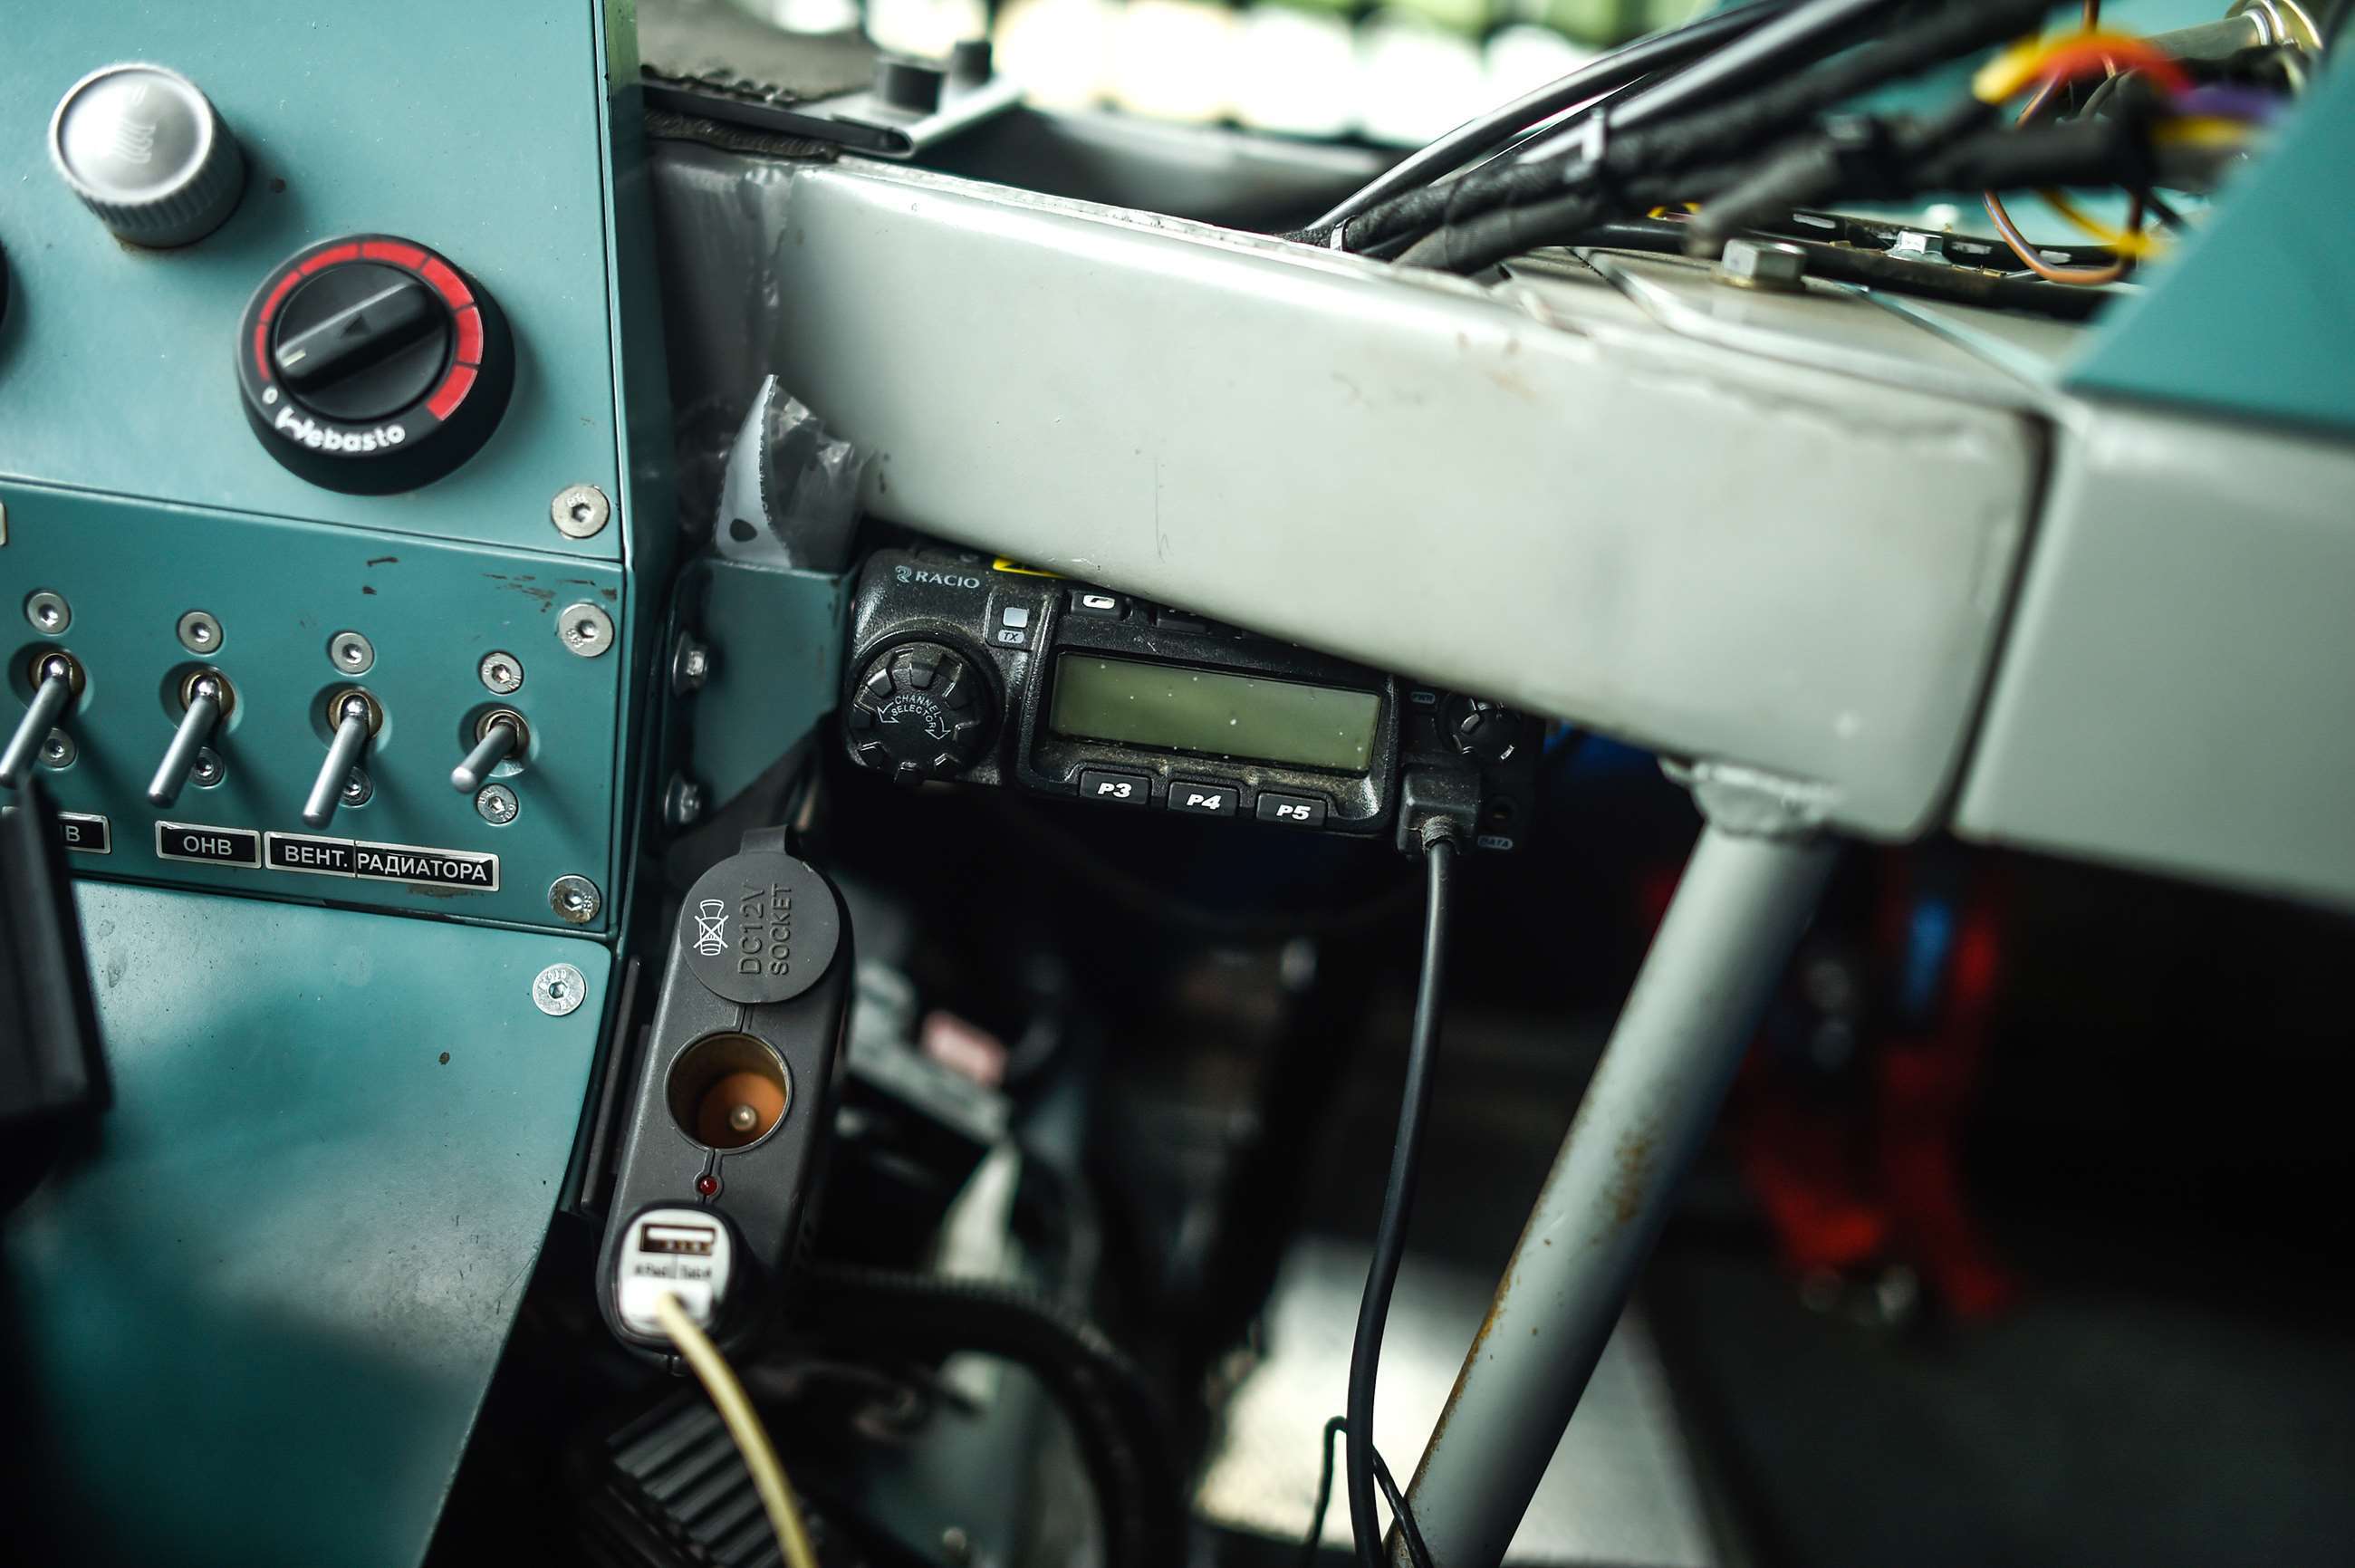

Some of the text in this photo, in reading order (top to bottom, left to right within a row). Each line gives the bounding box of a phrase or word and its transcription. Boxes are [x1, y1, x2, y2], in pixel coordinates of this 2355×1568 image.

[275, 405, 406, 452] Webasto
[915, 571, 980, 589] RACIO
[1003, 631, 1020, 642] TX
[891, 704, 937, 729] SELECTOR
[895, 694, 941, 718] CHANNEL
[1097, 782, 1132, 799] P3
[1187, 794, 1221, 811] P4
[1276, 804, 1312, 821] P5
[183, 835, 233, 856] ОНВ
[284, 845, 487, 881] ВЕНТ. РАДИАТОРА
[770, 883, 792, 976] SOCKET
